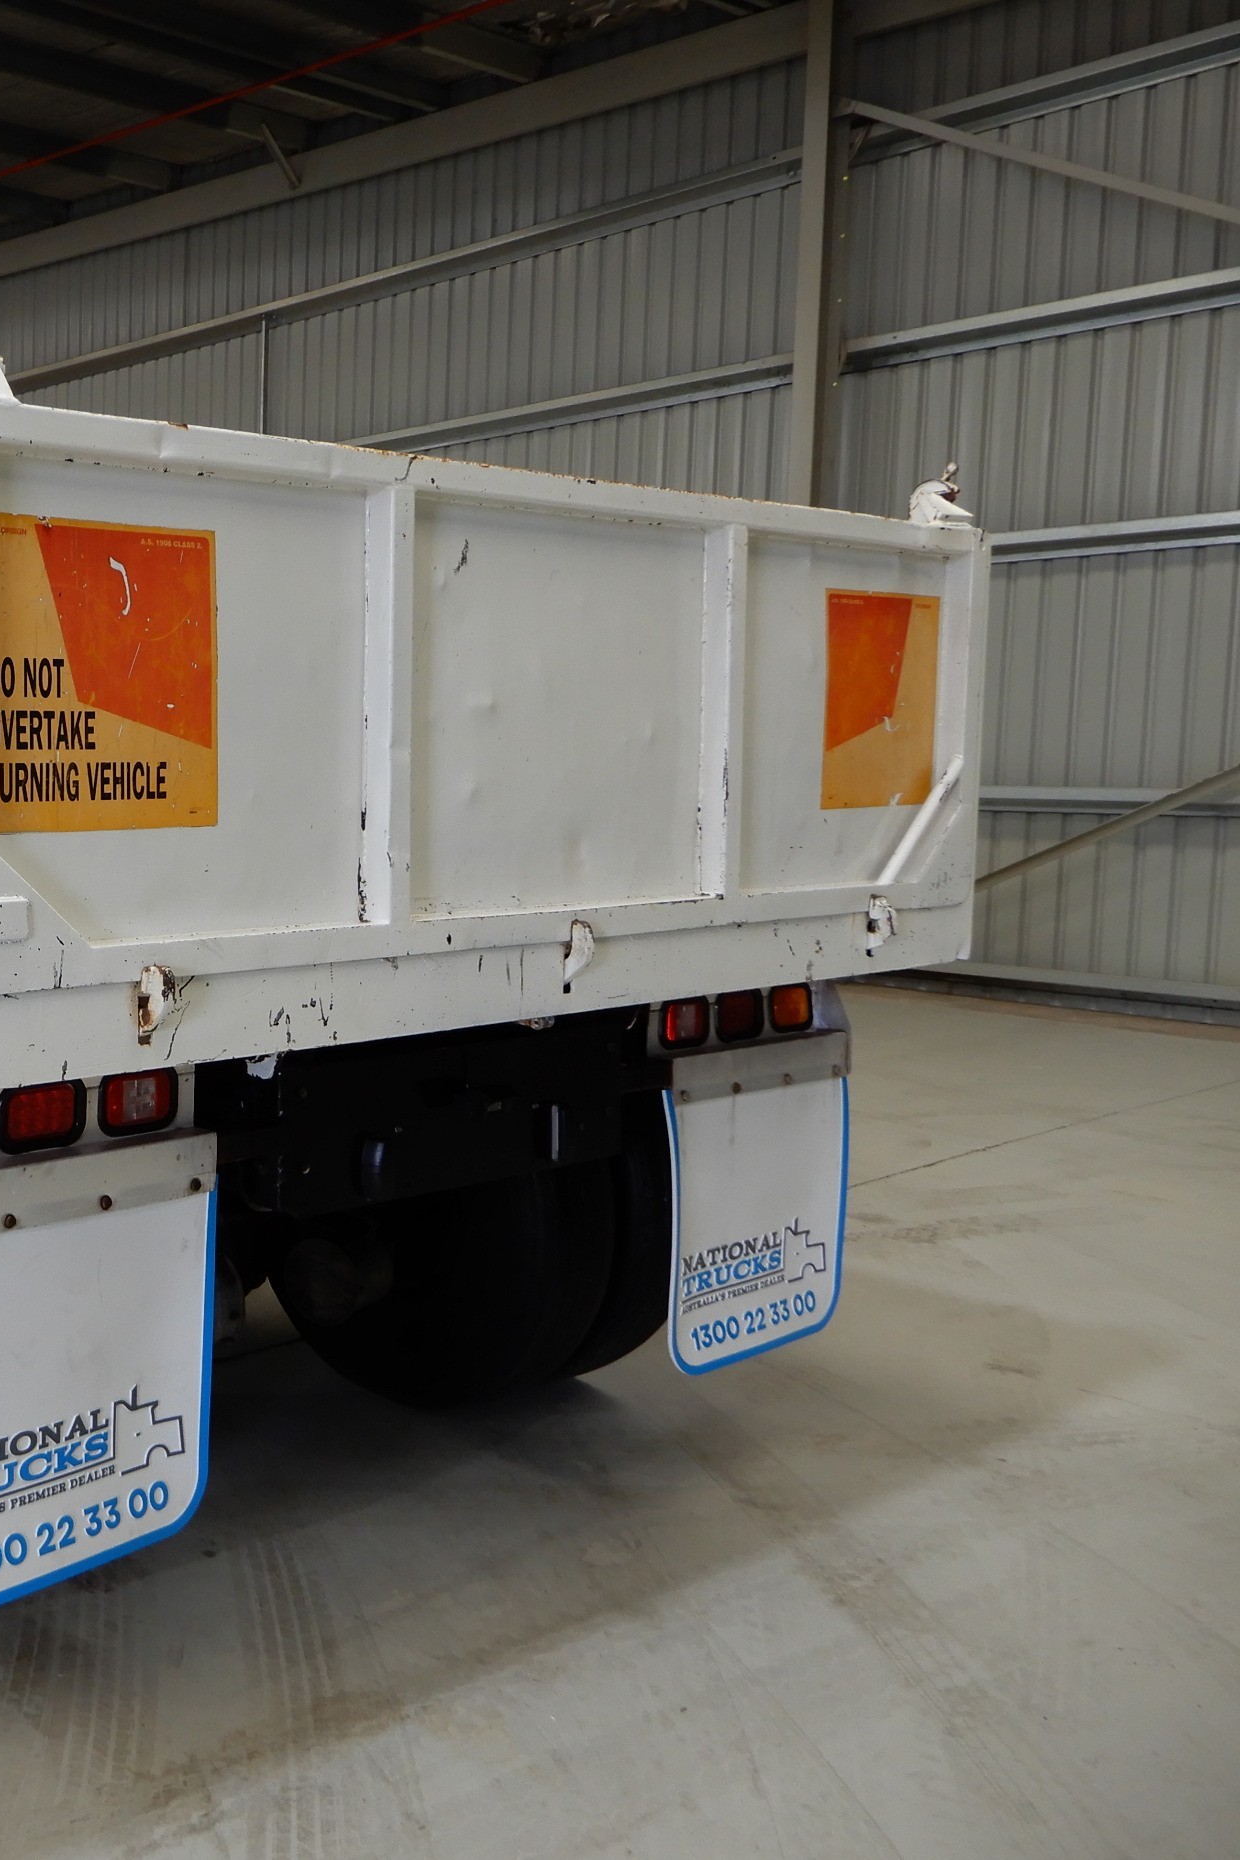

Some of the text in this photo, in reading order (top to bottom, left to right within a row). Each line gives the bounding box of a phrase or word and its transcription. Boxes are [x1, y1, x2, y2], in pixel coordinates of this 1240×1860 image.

[173, 541, 196, 549] CLASS
[24, 657, 64, 698] NOT
[87, 761, 167, 801] VEHICLE
[681, 1231, 782, 1276] NATIONAL
[682, 1249, 782, 1297] TRUCKS
[681, 1274, 785, 1315] AUSTRALIA'S PREMIER DEALER
[691, 1290, 816, 1351] 1300 22 33 00
[10, 1481, 67, 1509] PREMIER
[70, 1465, 116, 1490] DEALER
[35, 1515, 77, 1557] 22
[82, 1497, 122, 1537] 33
[128, 1480, 169, 1519] 00
